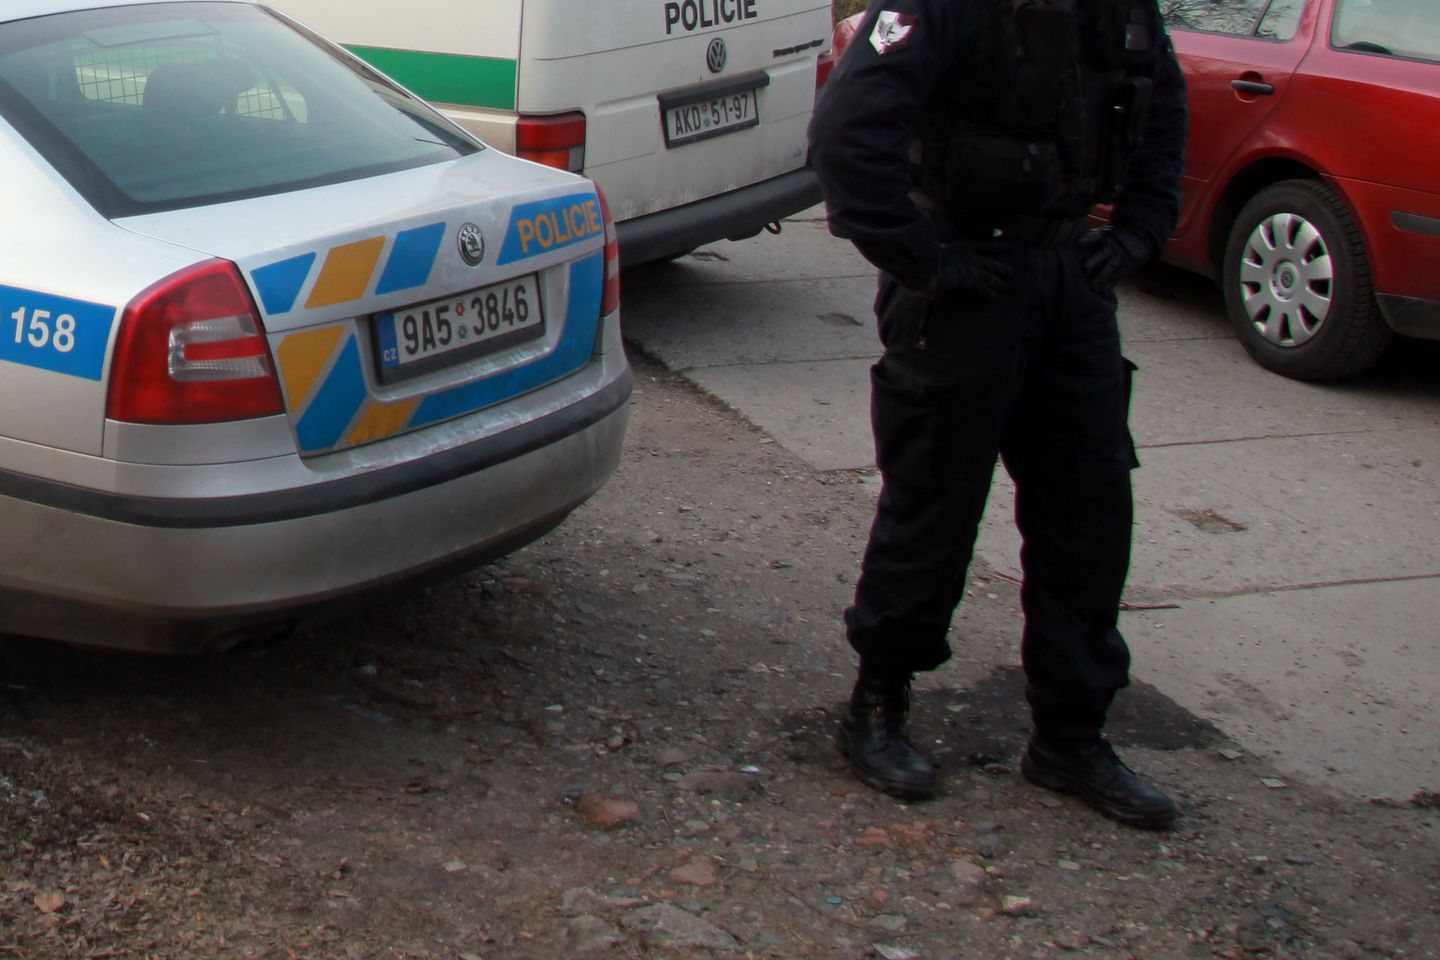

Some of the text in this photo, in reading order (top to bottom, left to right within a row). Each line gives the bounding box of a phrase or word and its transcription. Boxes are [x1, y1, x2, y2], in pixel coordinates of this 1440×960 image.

[674, 93, 749, 136] AKD 51-97
[517, 200, 601, 254] POLICIE
[11, 306, 76, 353] 158
[402, 284, 529, 355] 9A5 3846
[383, 349, 398, 362] CZ
